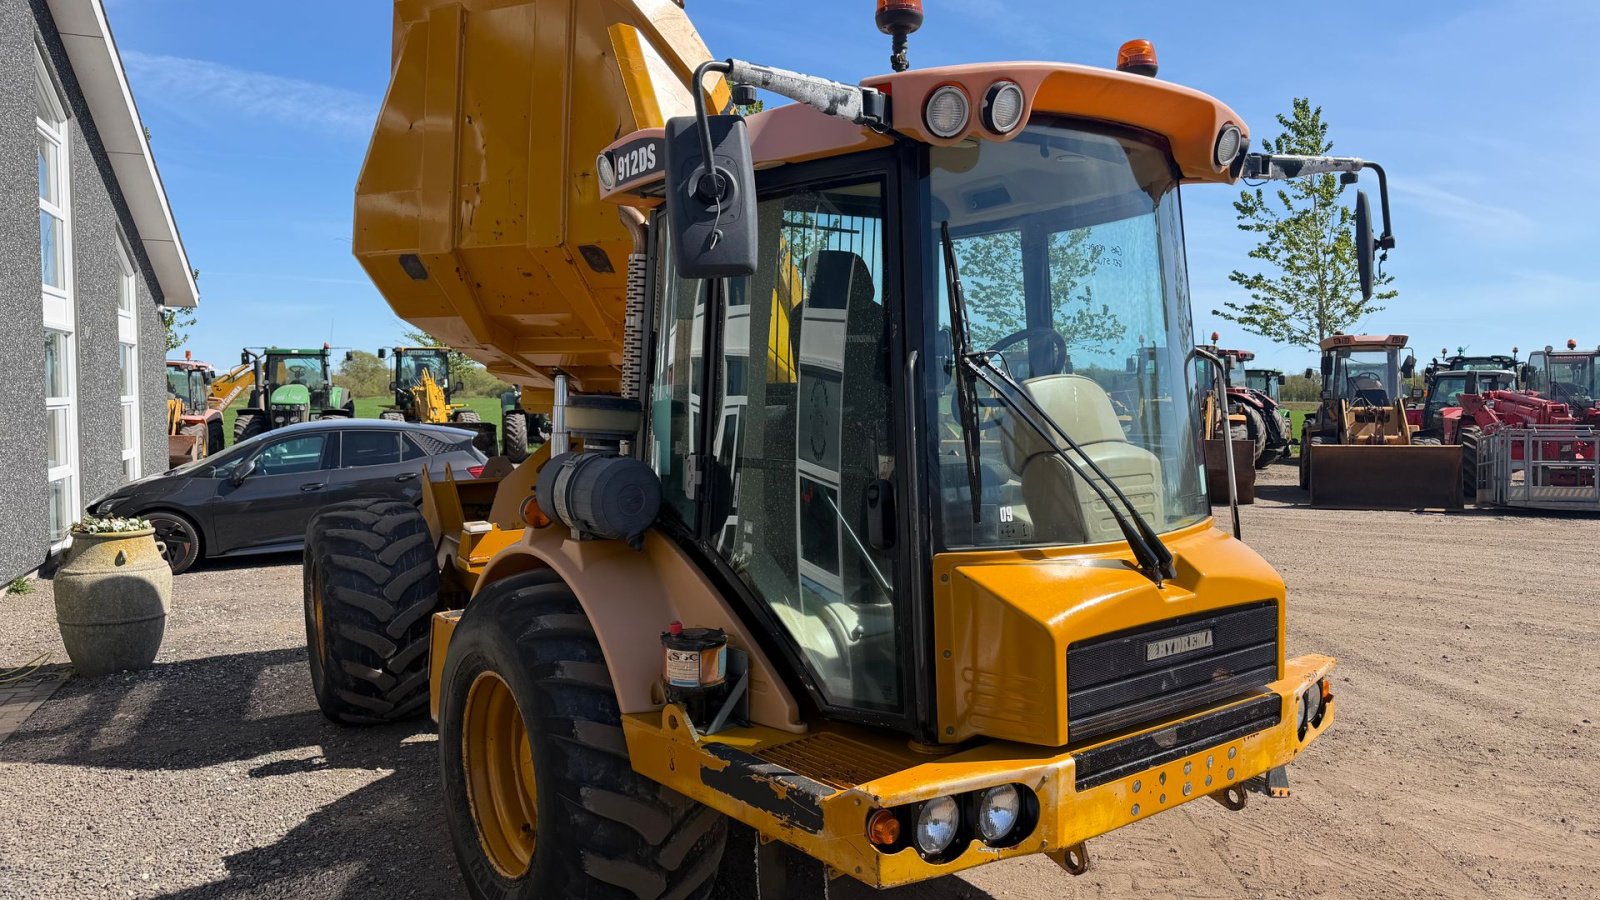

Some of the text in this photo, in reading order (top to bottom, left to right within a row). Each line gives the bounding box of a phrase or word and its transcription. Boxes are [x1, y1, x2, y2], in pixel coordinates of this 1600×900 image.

[617, 143, 656, 181] 912DS
[999, 506, 1013, 523] 09
[1156, 630, 1213, 656] HYDREMA
